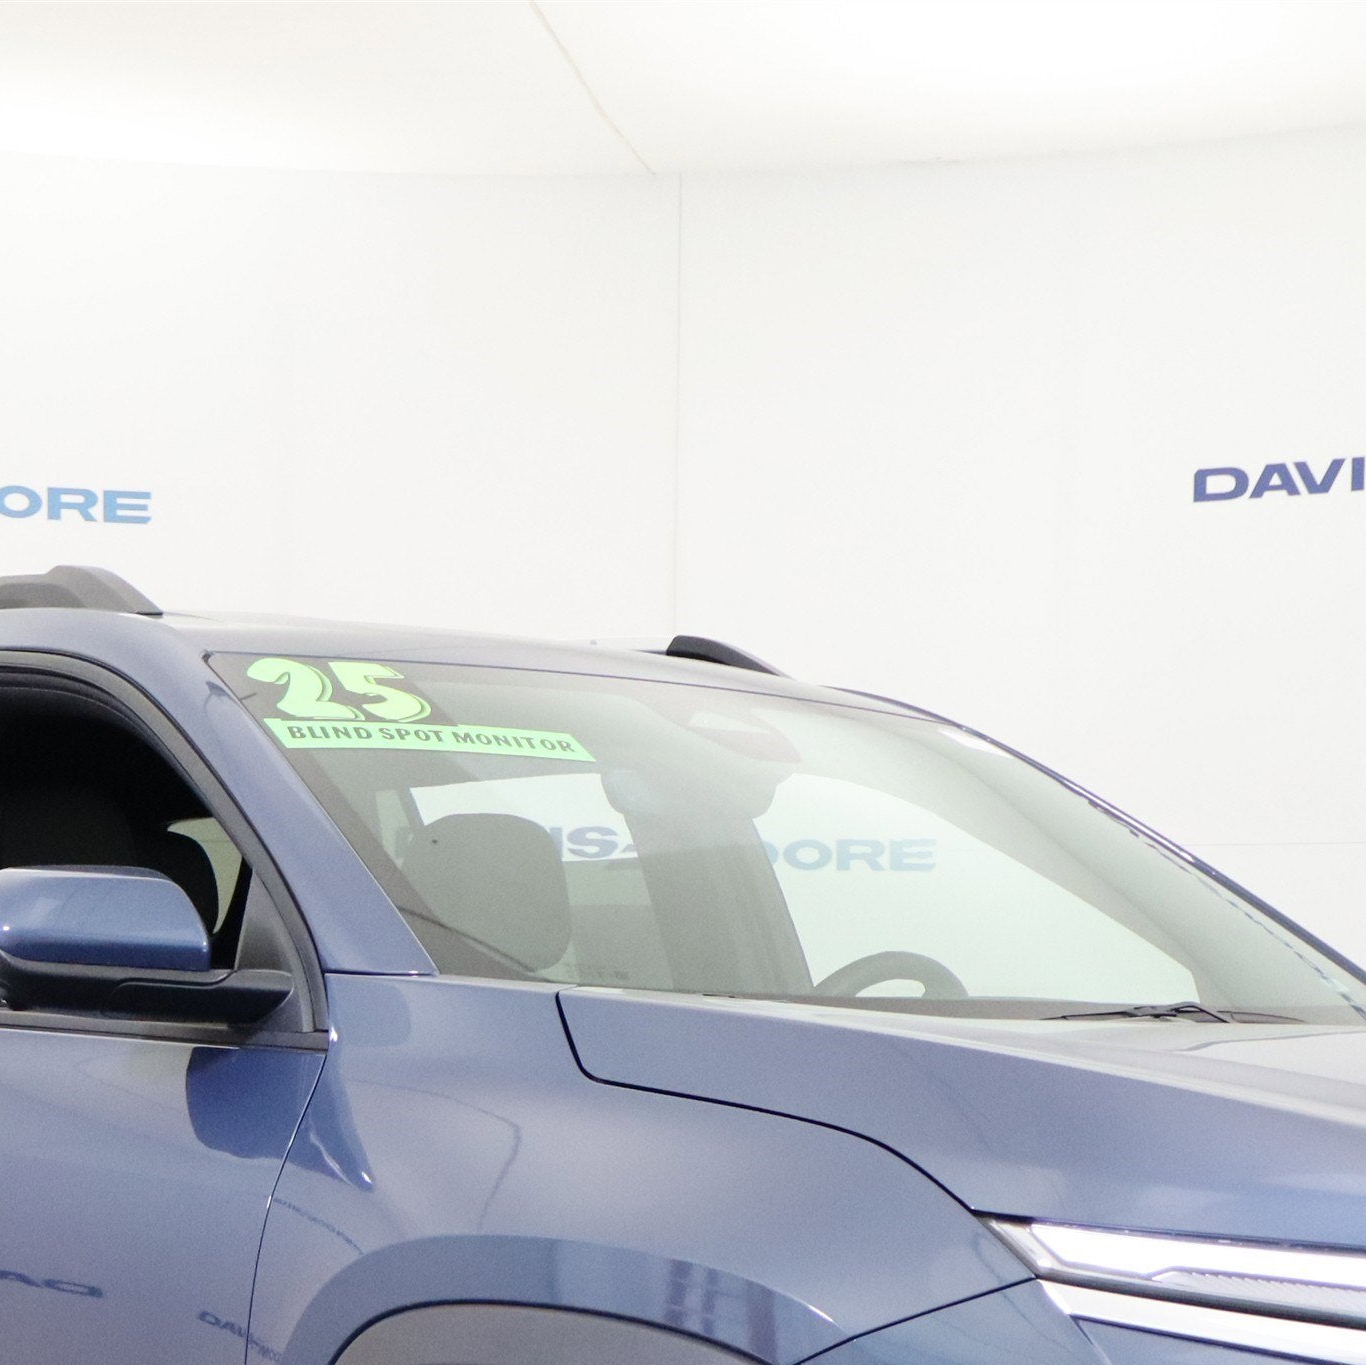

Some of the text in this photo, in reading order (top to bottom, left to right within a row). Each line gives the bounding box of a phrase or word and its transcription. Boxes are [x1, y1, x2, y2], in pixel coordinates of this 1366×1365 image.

[246, 657, 432, 722] 25
[288, 725, 576, 753] BLIND SPOT MONITOR
